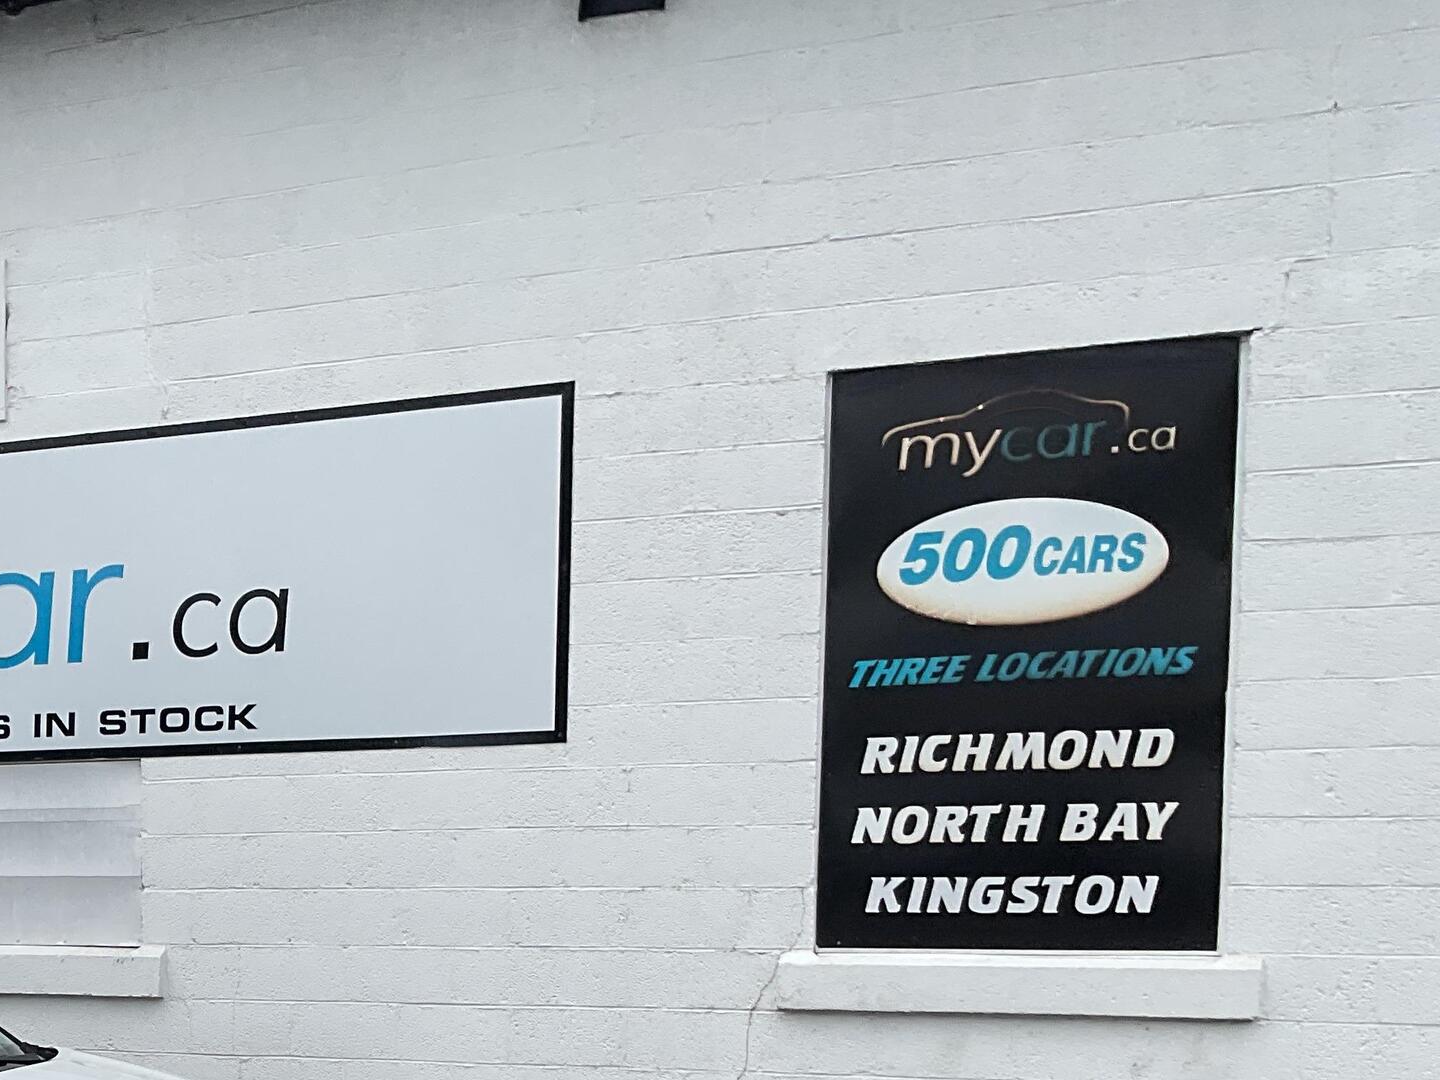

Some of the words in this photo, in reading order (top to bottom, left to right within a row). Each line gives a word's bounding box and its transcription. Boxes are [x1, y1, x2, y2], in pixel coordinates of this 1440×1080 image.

[899, 524, 1032, 586] 500
[1033, 531, 1147, 577] CARS
[848, 654, 971, 688] THREE
[975, 645, 1199, 683] LOCATIONS
[33, 711, 76, 738] IN
[98, 703, 258, 735] STOCK
[860, 728, 1175, 775] RICHMOND
[850, 804, 1046, 844] NORTH
[1059, 801, 1180, 842] BAY
[864, 874, 1160, 915] KINGSTON
